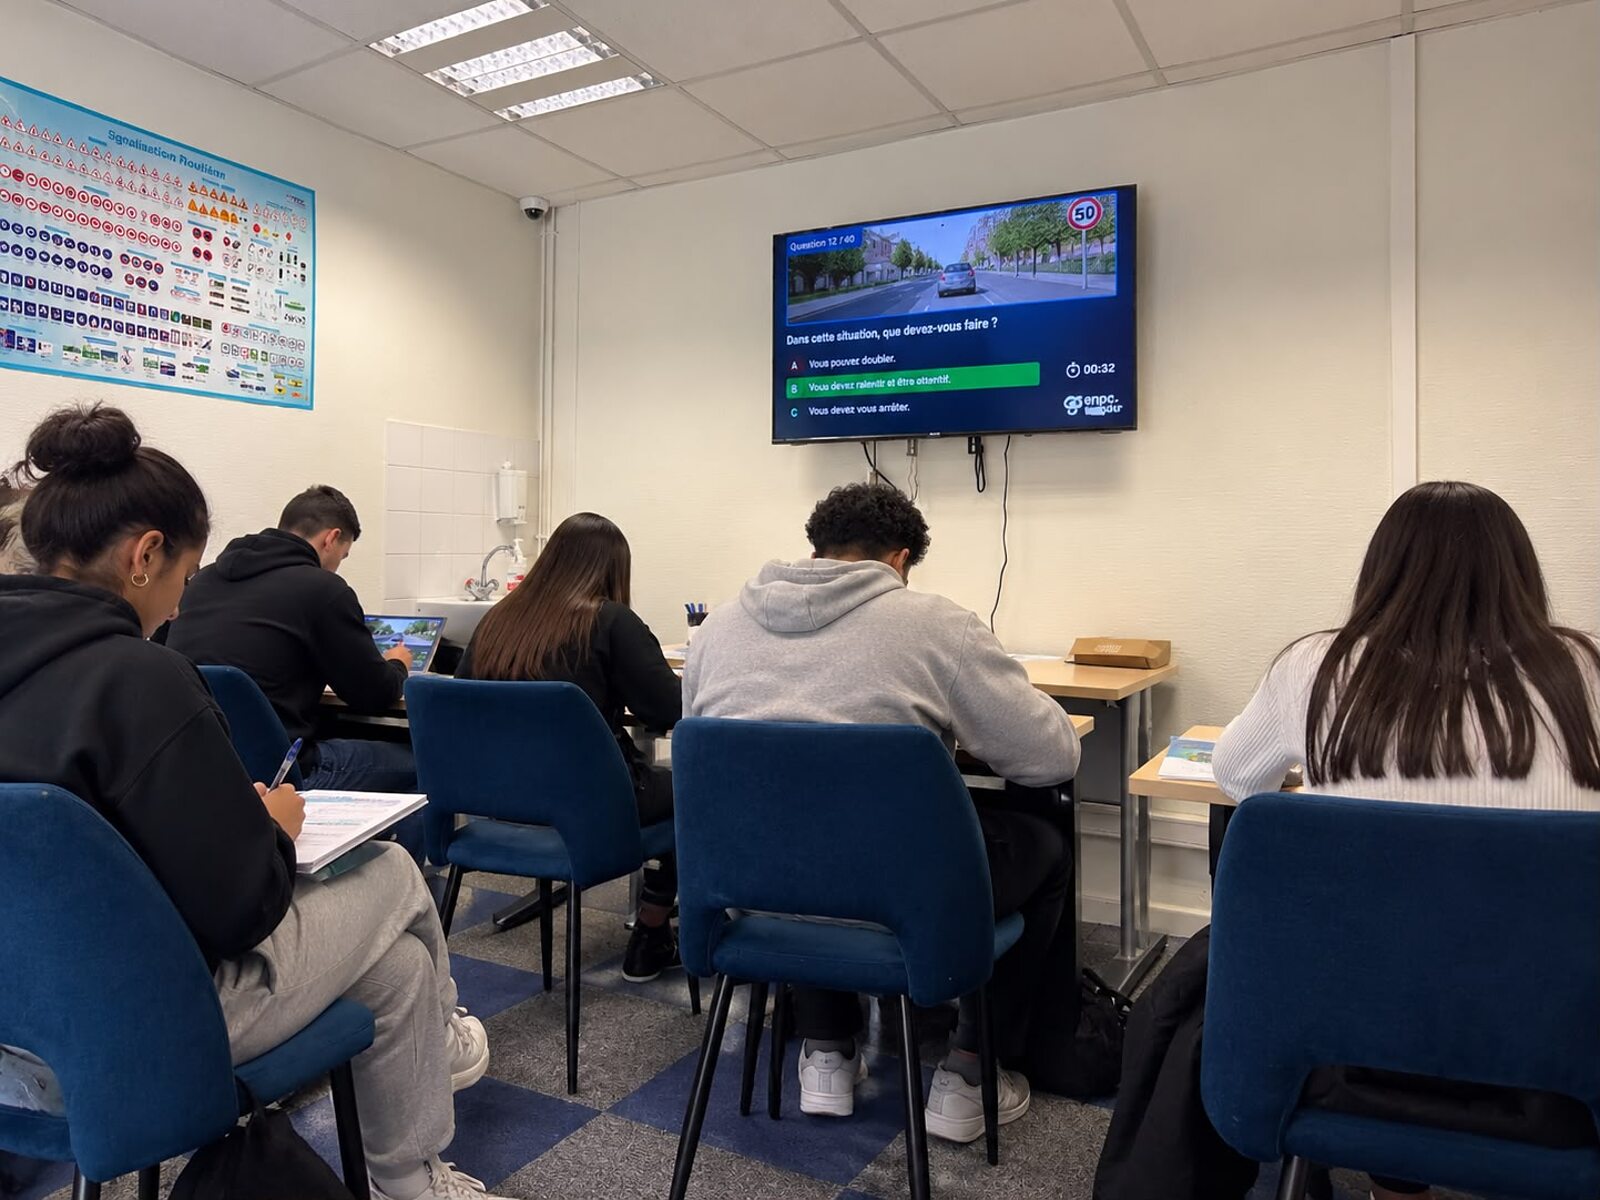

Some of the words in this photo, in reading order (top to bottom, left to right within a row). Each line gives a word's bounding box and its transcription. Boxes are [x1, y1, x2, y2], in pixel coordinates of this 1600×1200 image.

[1075, 205, 1095, 221] 50
[828, 237, 837, 246] 12
[844, 234, 855, 243] 40
[786, 334, 809, 345] Dans
[811, 332, 835, 343] cette
[836, 327, 880, 341] situation,
[882, 328, 901, 340] que
[903, 323, 962, 335] devez-vous
[964, 319, 989, 330] faire
[991, 317, 998, 328] ?
[791, 361, 798, 370] A
[808, 359, 829, 369] Vous
[1083, 363, 1116, 375] 00:32
[791, 384, 798, 393] B
[808, 383, 829, 391] Vous
[790, 407, 798, 417] C
[808, 406, 829, 415] Vous
[830, 405, 855, 415] devez
[856, 405, 877, 413] vous
